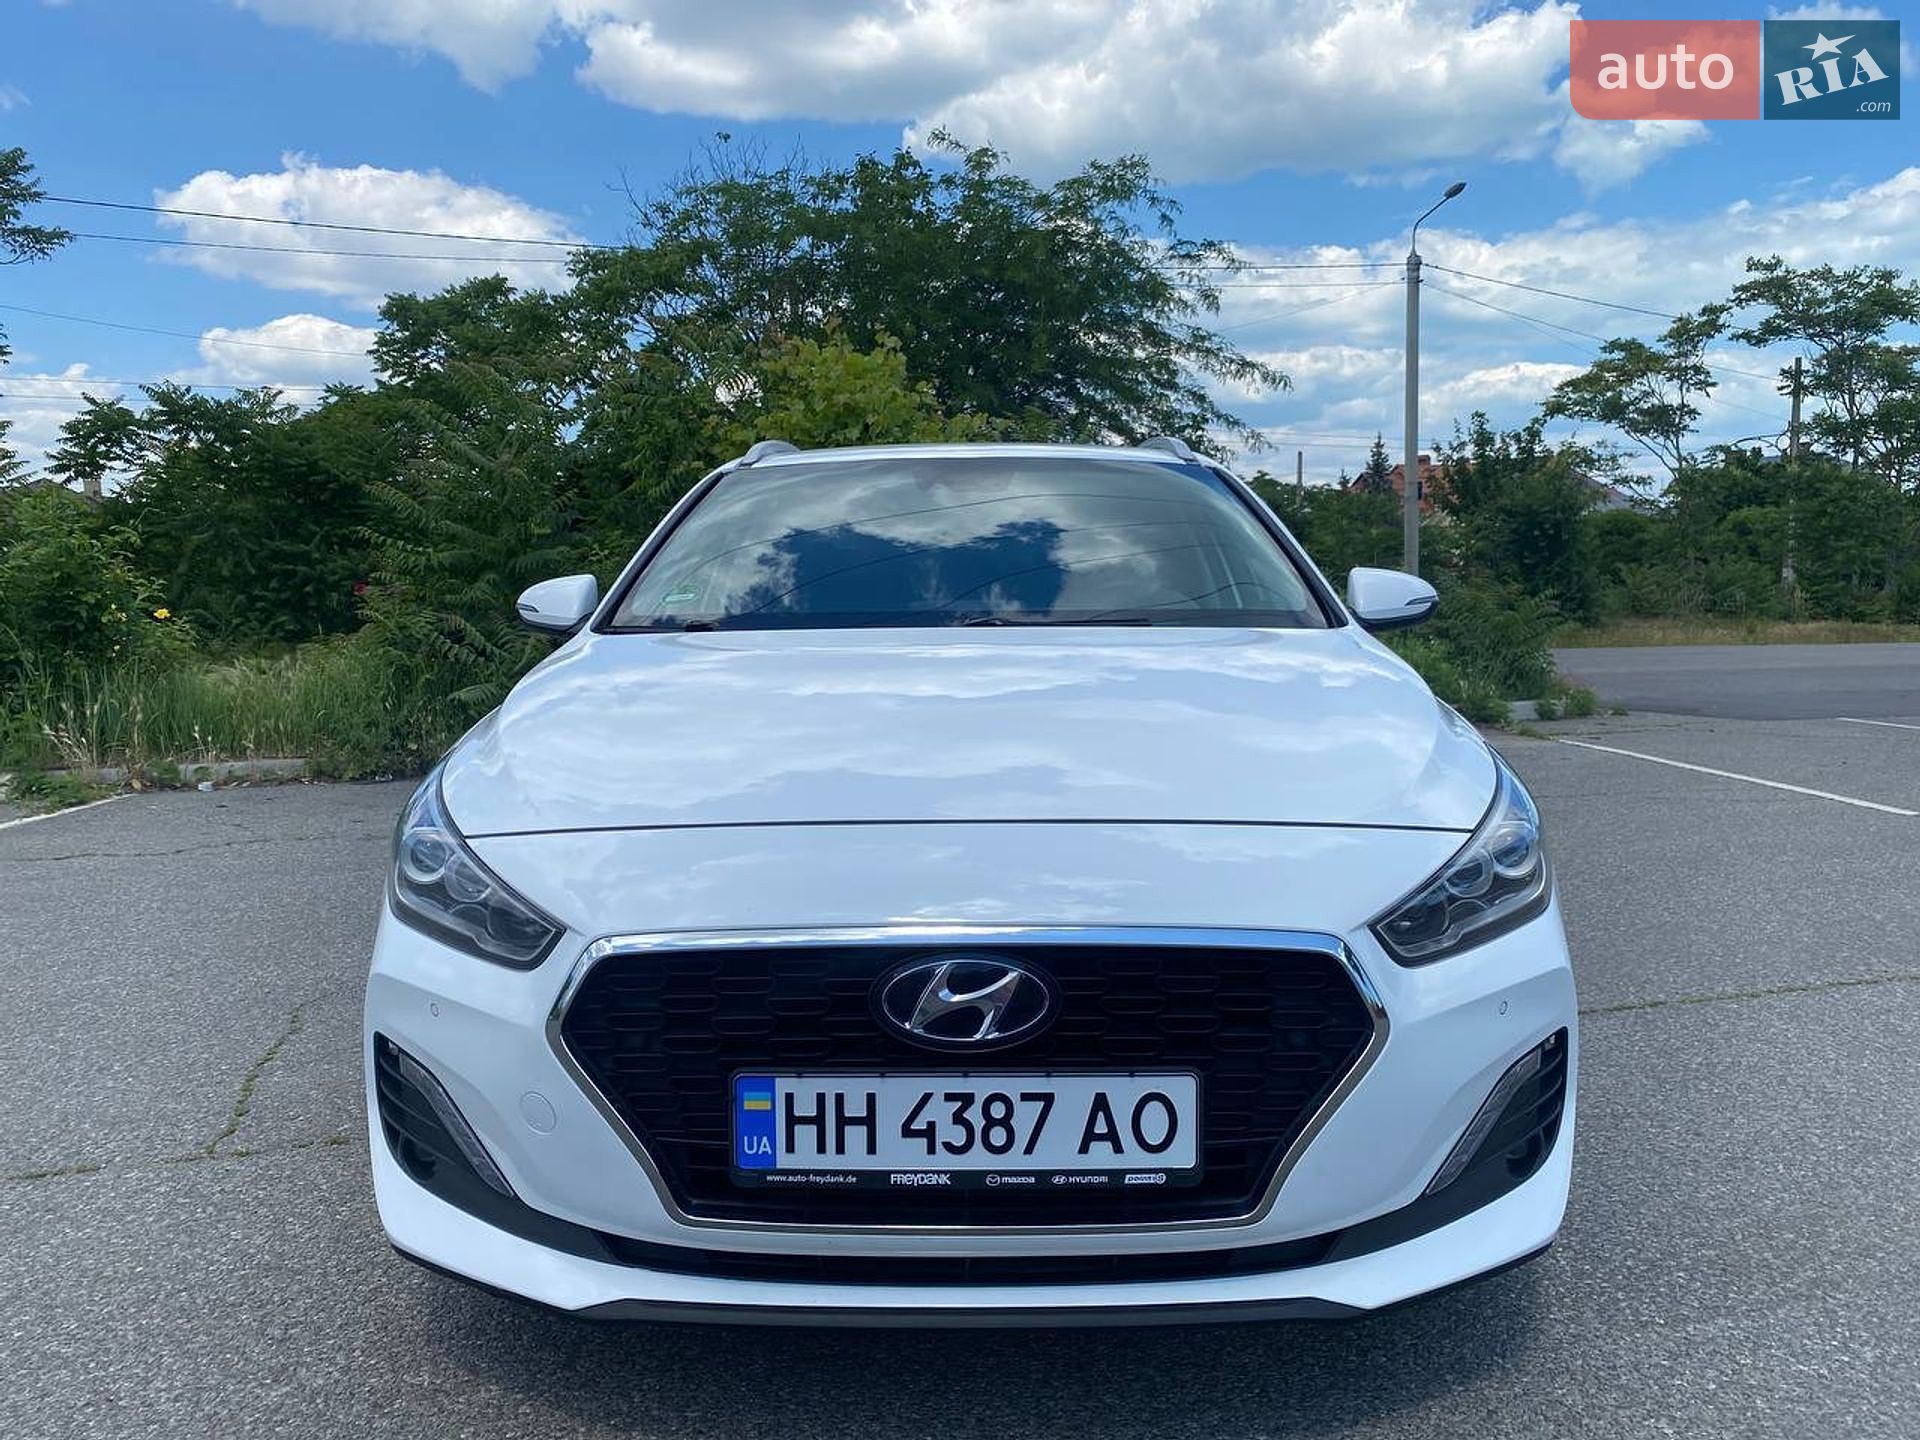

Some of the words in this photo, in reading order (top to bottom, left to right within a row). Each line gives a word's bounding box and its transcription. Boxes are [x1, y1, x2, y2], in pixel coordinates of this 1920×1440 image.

[784, 1091, 877, 1155] HH
[901, 1091, 1056, 1155] 4387
[1077, 1091, 1179, 1155] AO
[743, 1136, 772, 1155] UA
[766, 1173, 857, 1185] www.auto-freydank.de
